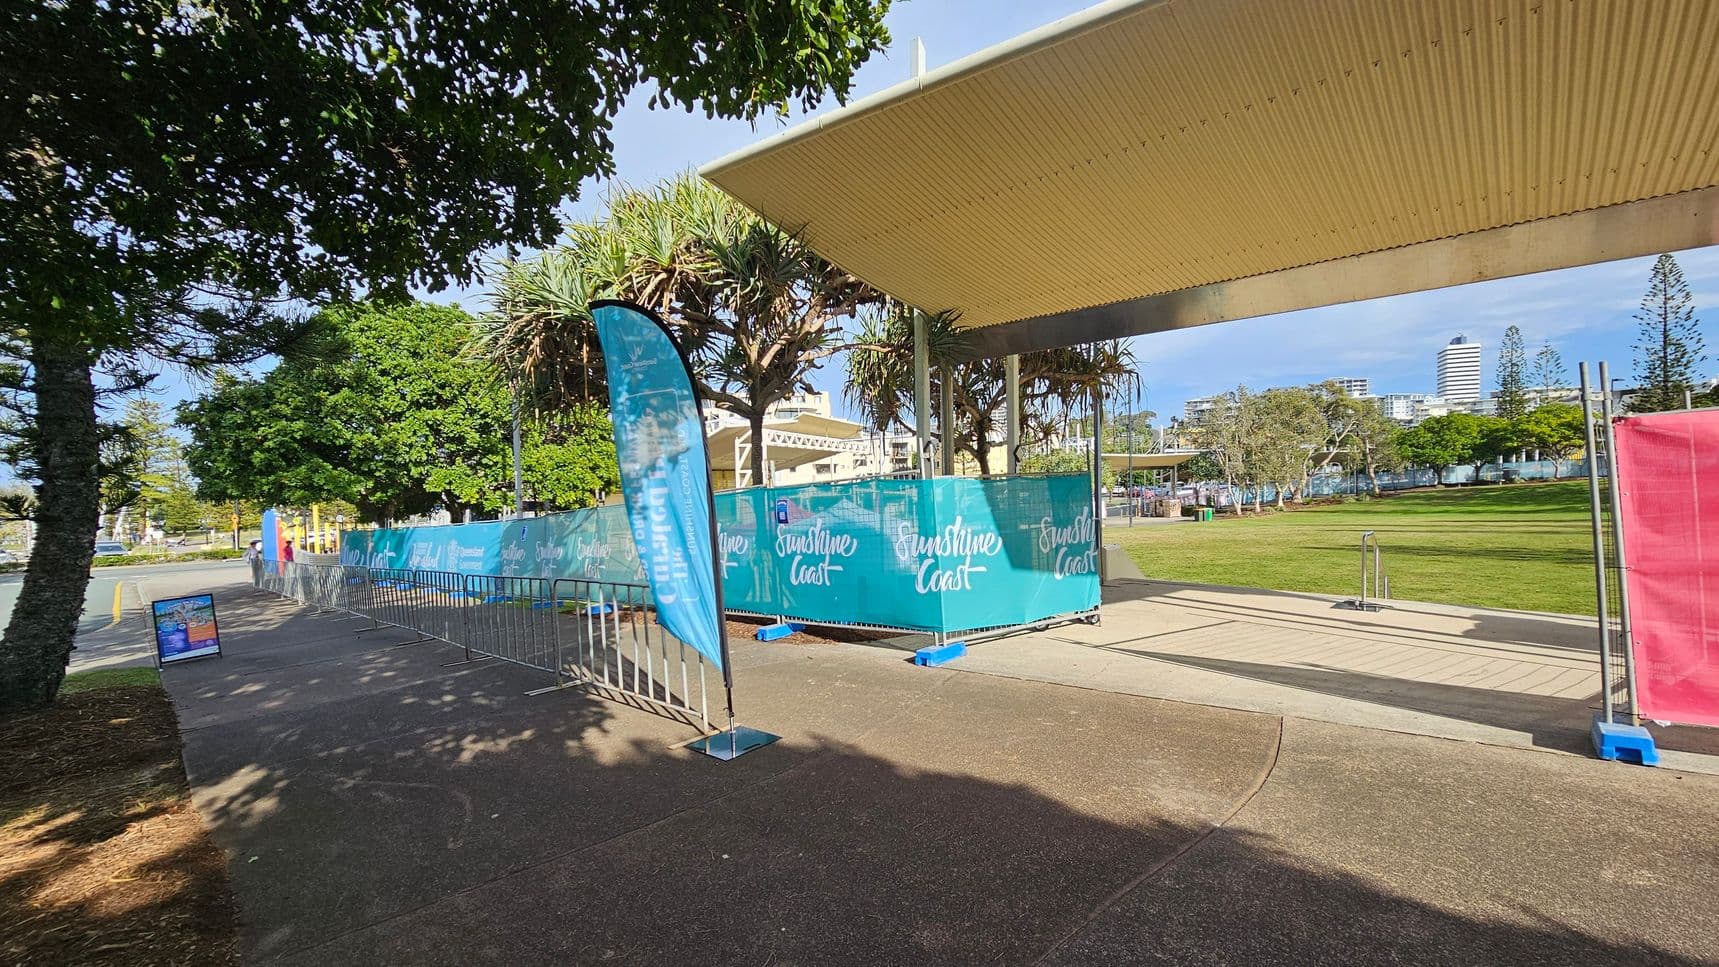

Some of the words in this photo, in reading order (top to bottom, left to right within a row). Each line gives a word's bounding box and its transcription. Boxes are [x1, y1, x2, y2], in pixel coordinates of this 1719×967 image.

[717, 522, 749, 555] hine
[775, 518, 858, 558] Sunshine
[895, 516, 1003, 560] Sunshine
[1039, 506, 1097, 553] Sunshi
[790, 555, 844, 586] Coast
[915, 558, 988, 594] Coast
[1053, 547, 1098, 580] Coast
